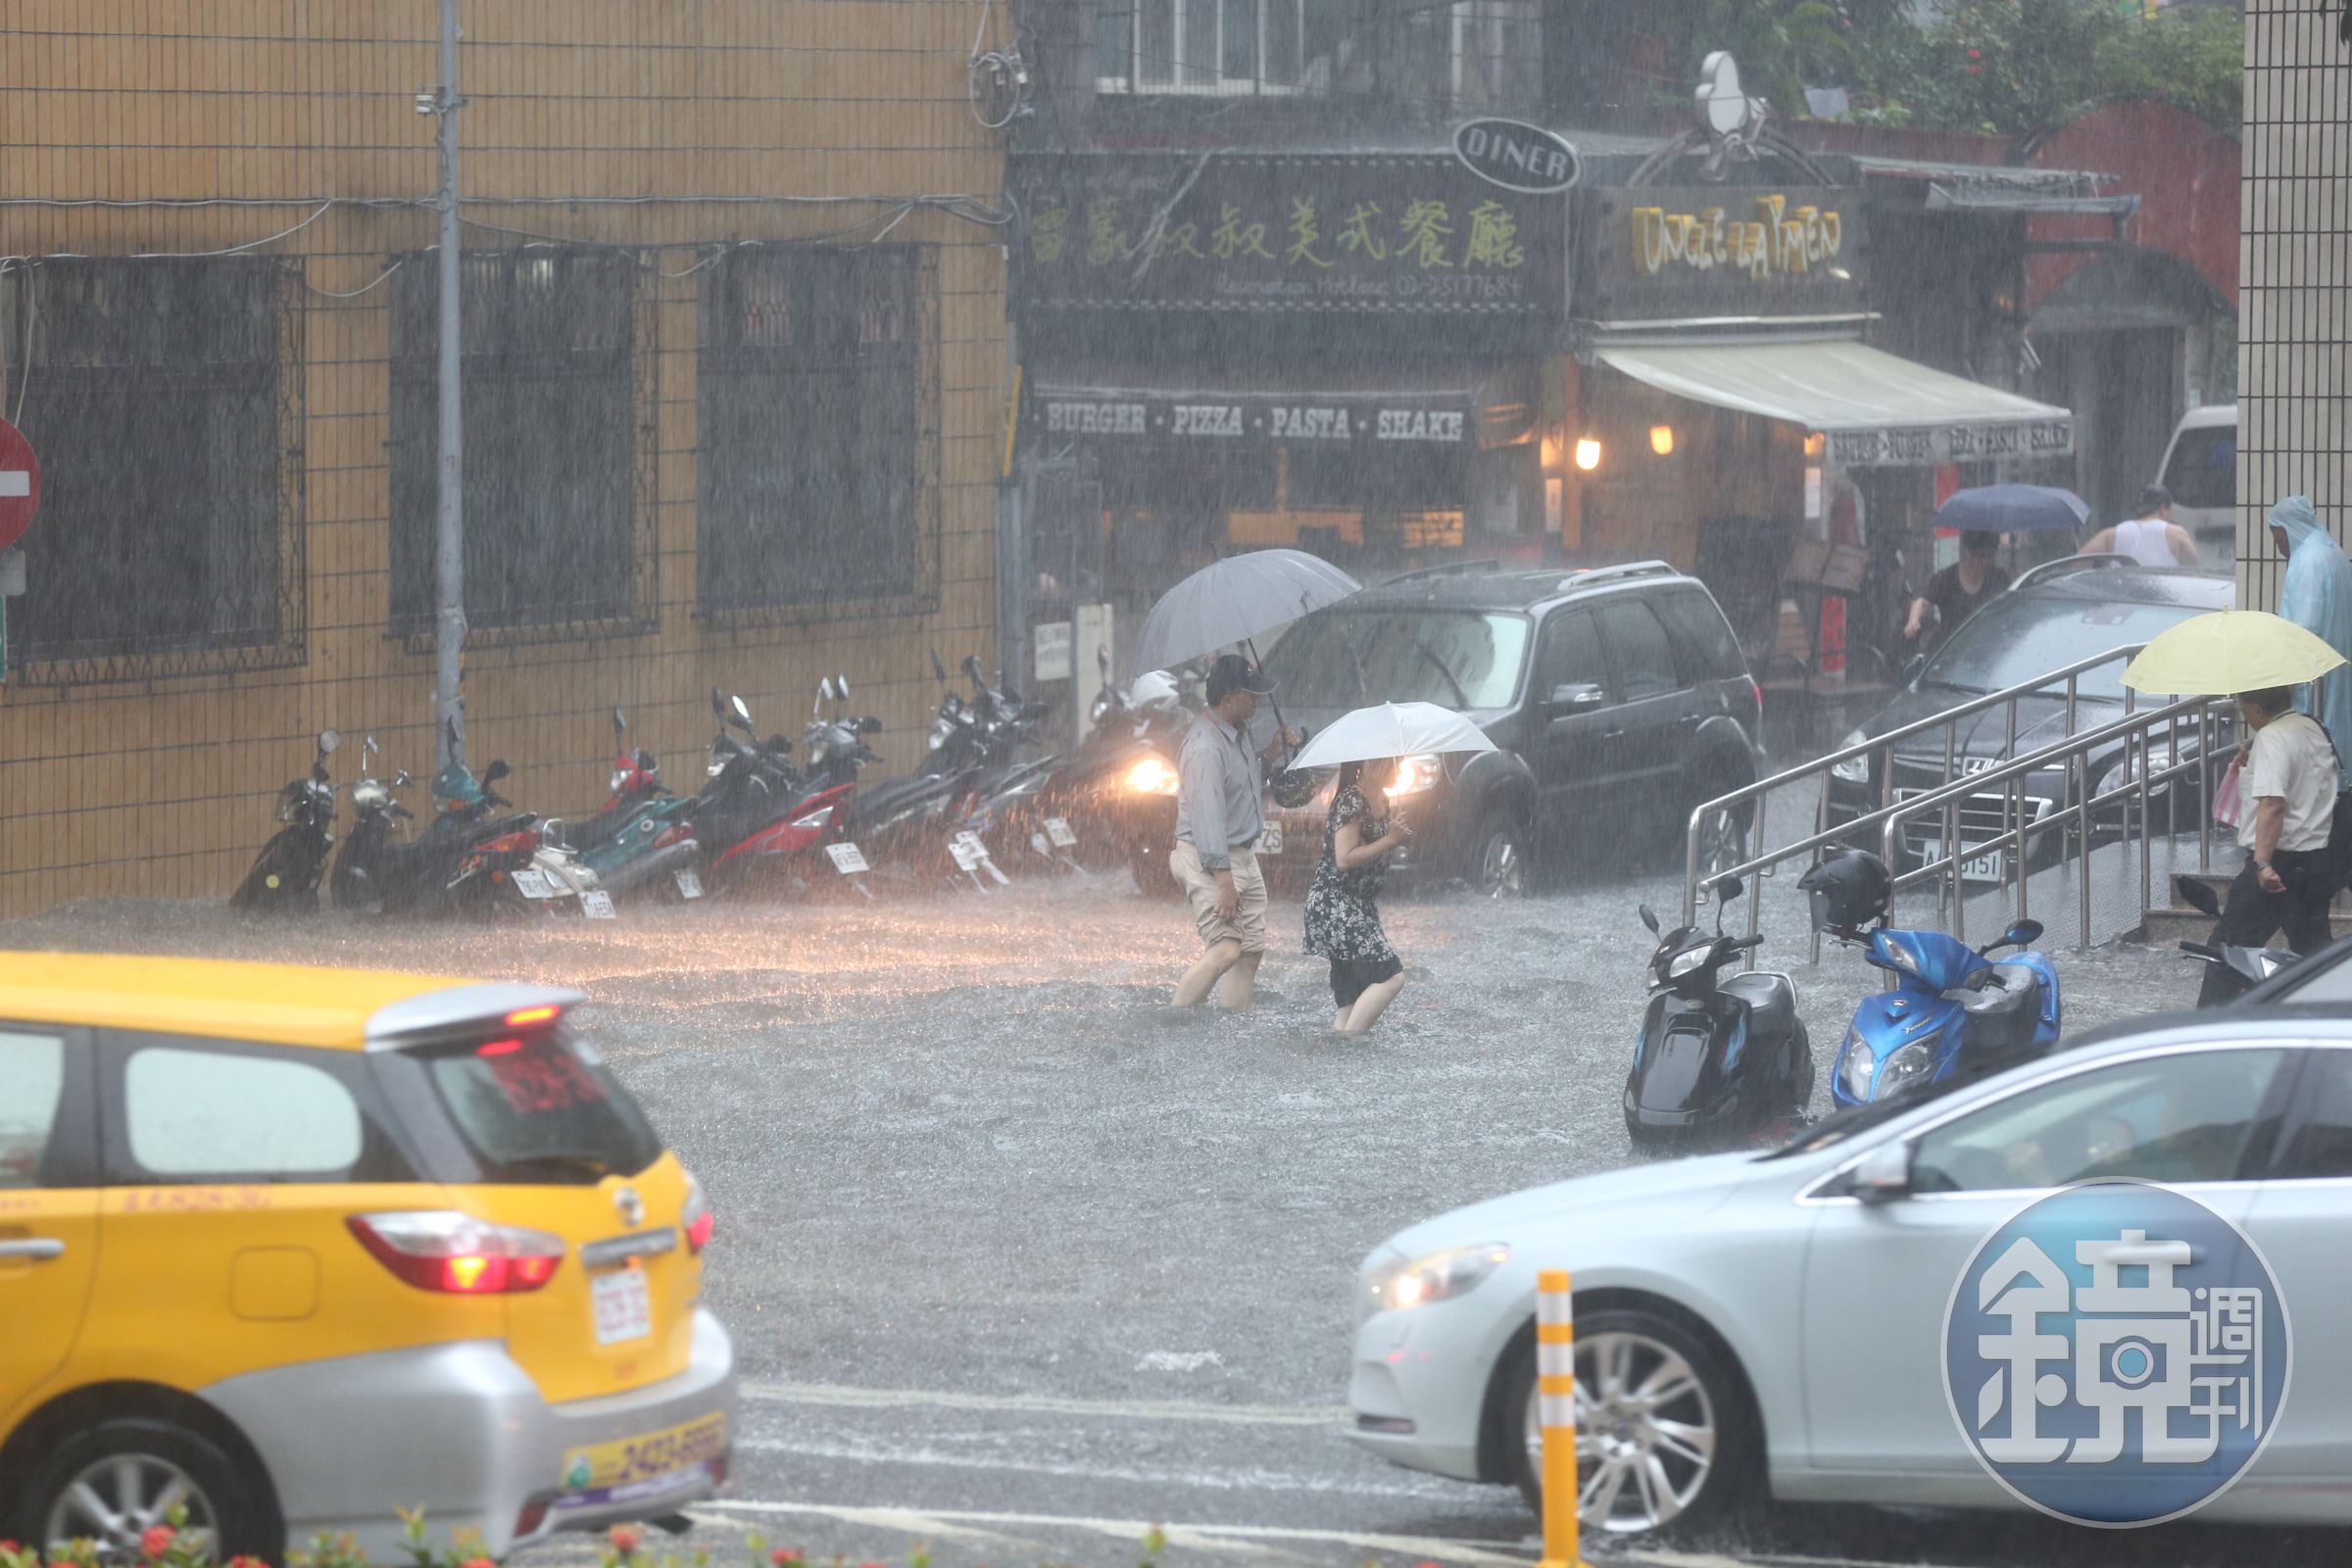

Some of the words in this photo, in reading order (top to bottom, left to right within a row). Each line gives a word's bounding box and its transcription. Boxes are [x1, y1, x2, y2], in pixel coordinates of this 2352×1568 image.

[1466, 126, 1568, 181] DINER
[1048, 403, 1146, 434] BURGER
[1172, 405, 1244, 436] PIZZA
[1270, 407, 1350, 439] PASTA
[1376, 409, 1464, 441] SHAKE
